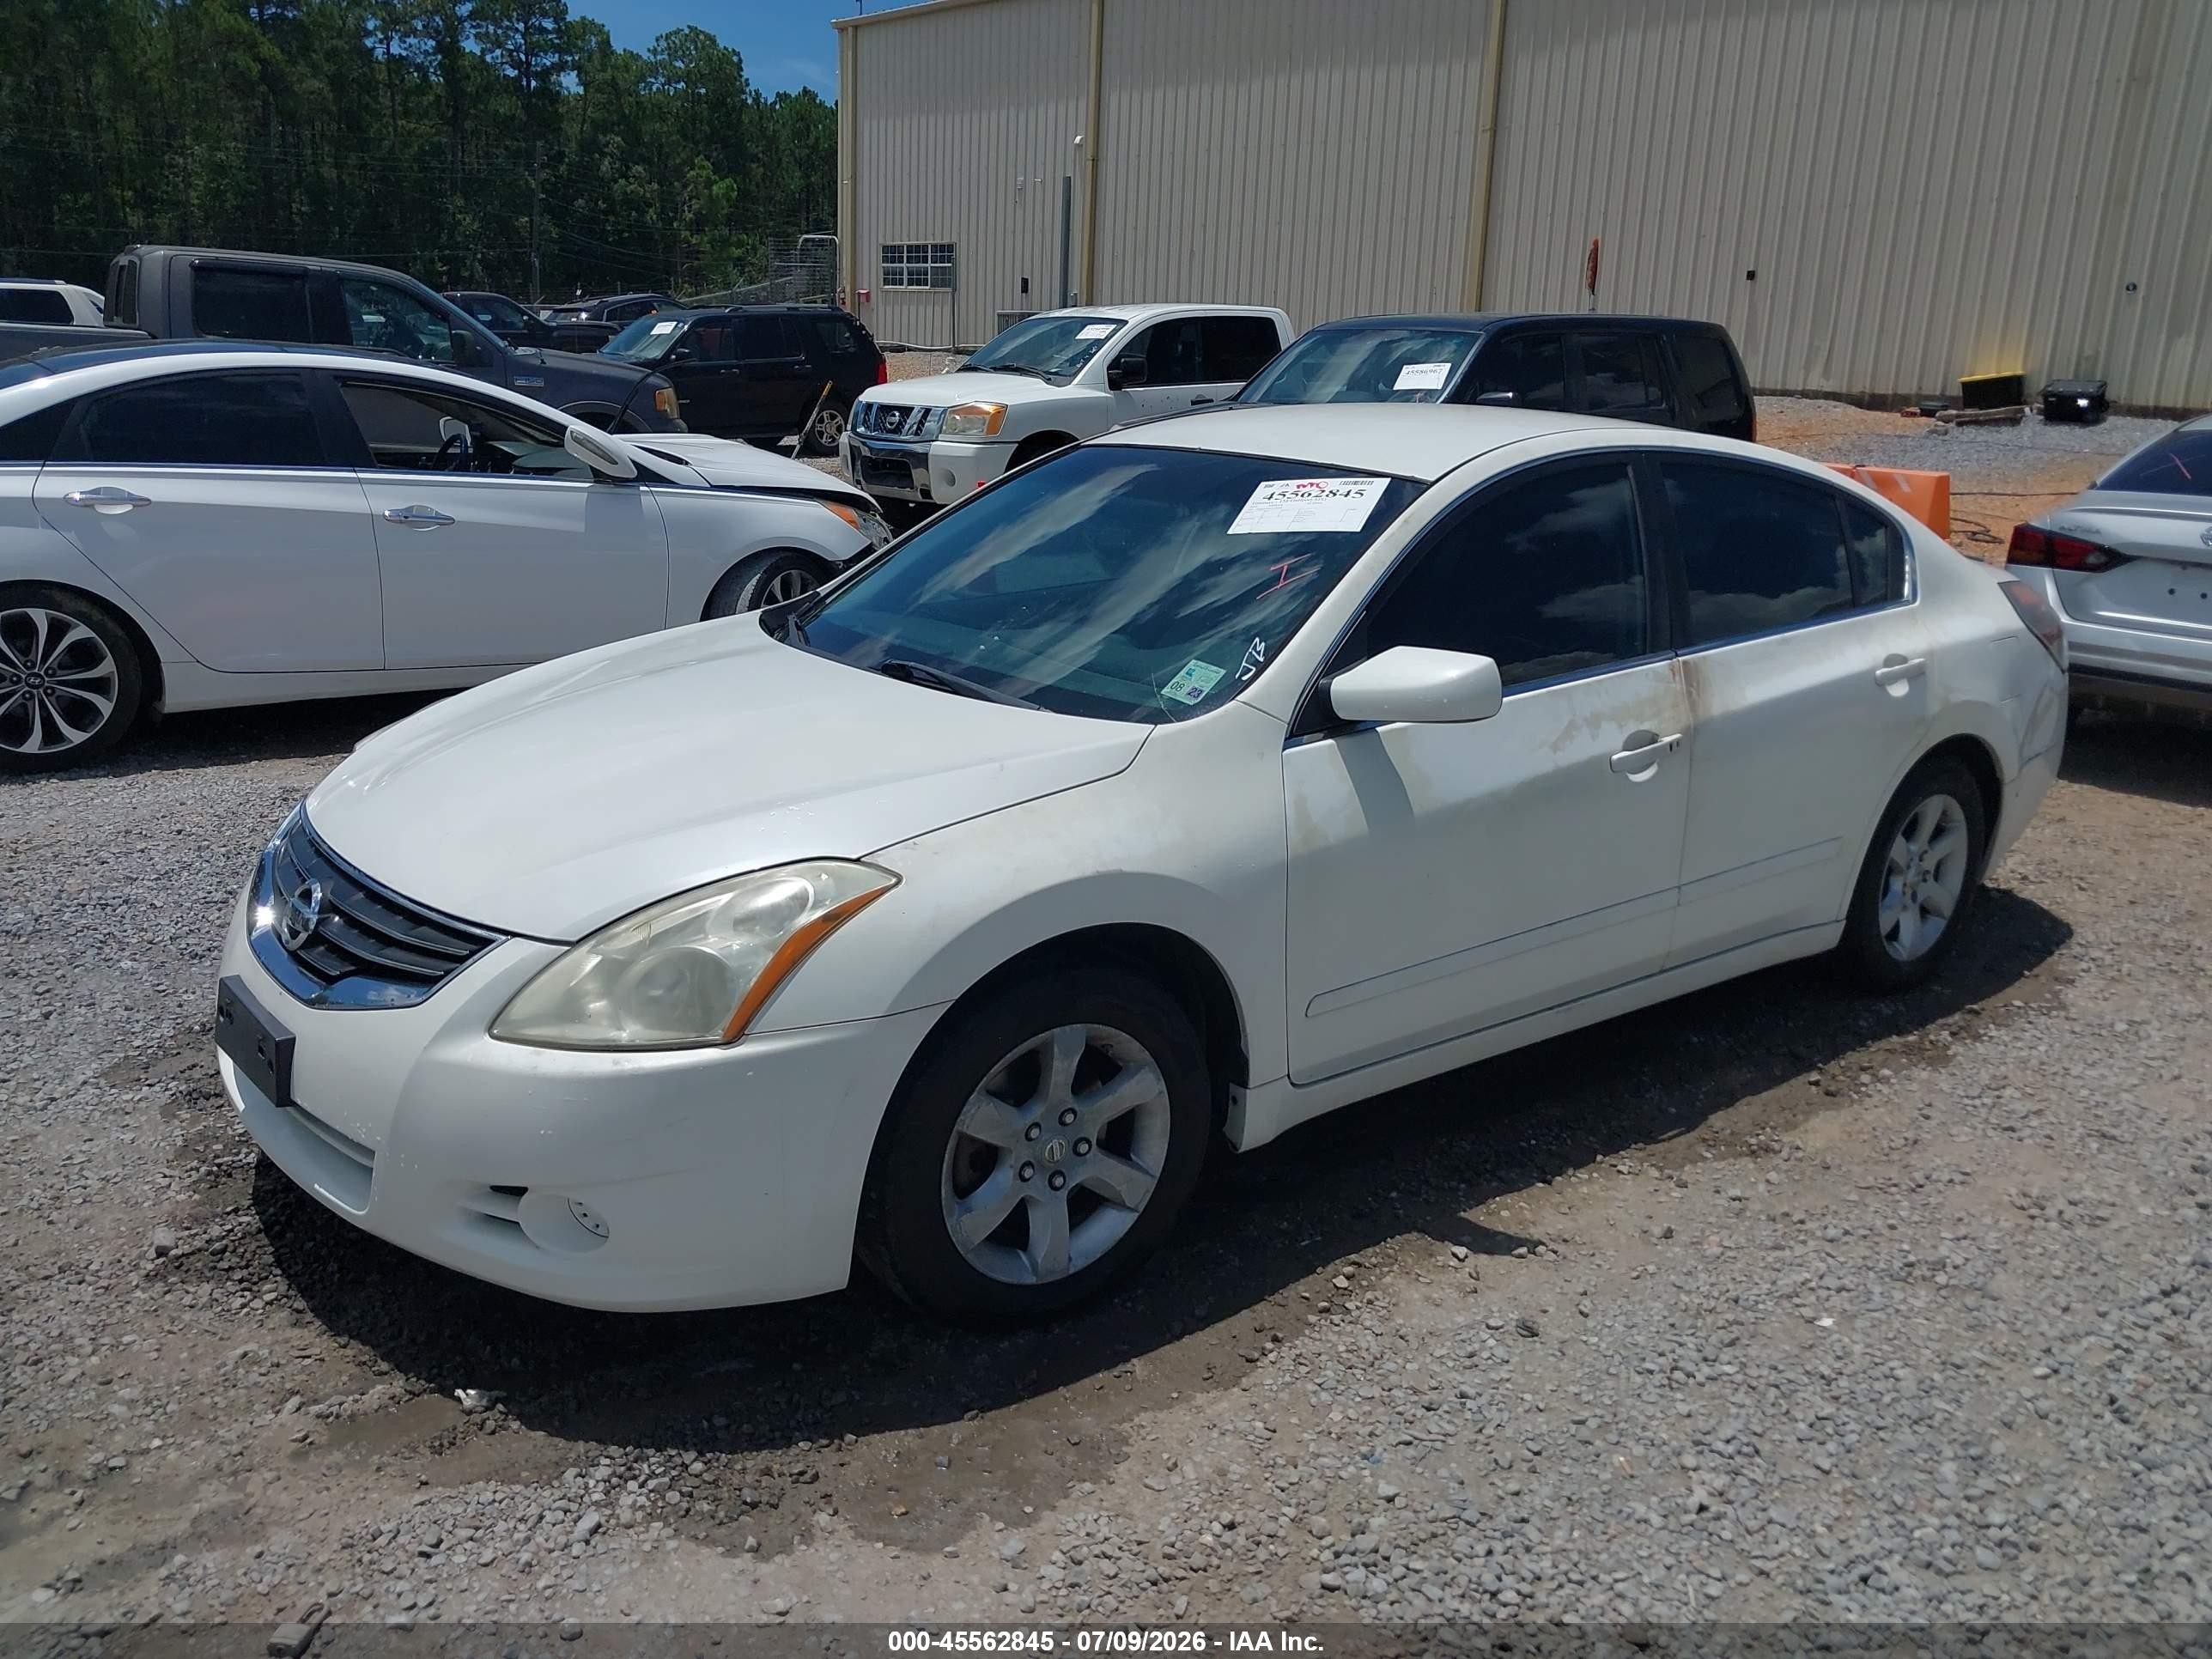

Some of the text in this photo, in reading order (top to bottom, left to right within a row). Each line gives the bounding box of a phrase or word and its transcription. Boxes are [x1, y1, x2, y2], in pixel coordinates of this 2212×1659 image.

[1262, 489, 1367, 501] 45562845
[1170, 681, 1203, 698] 08 23
